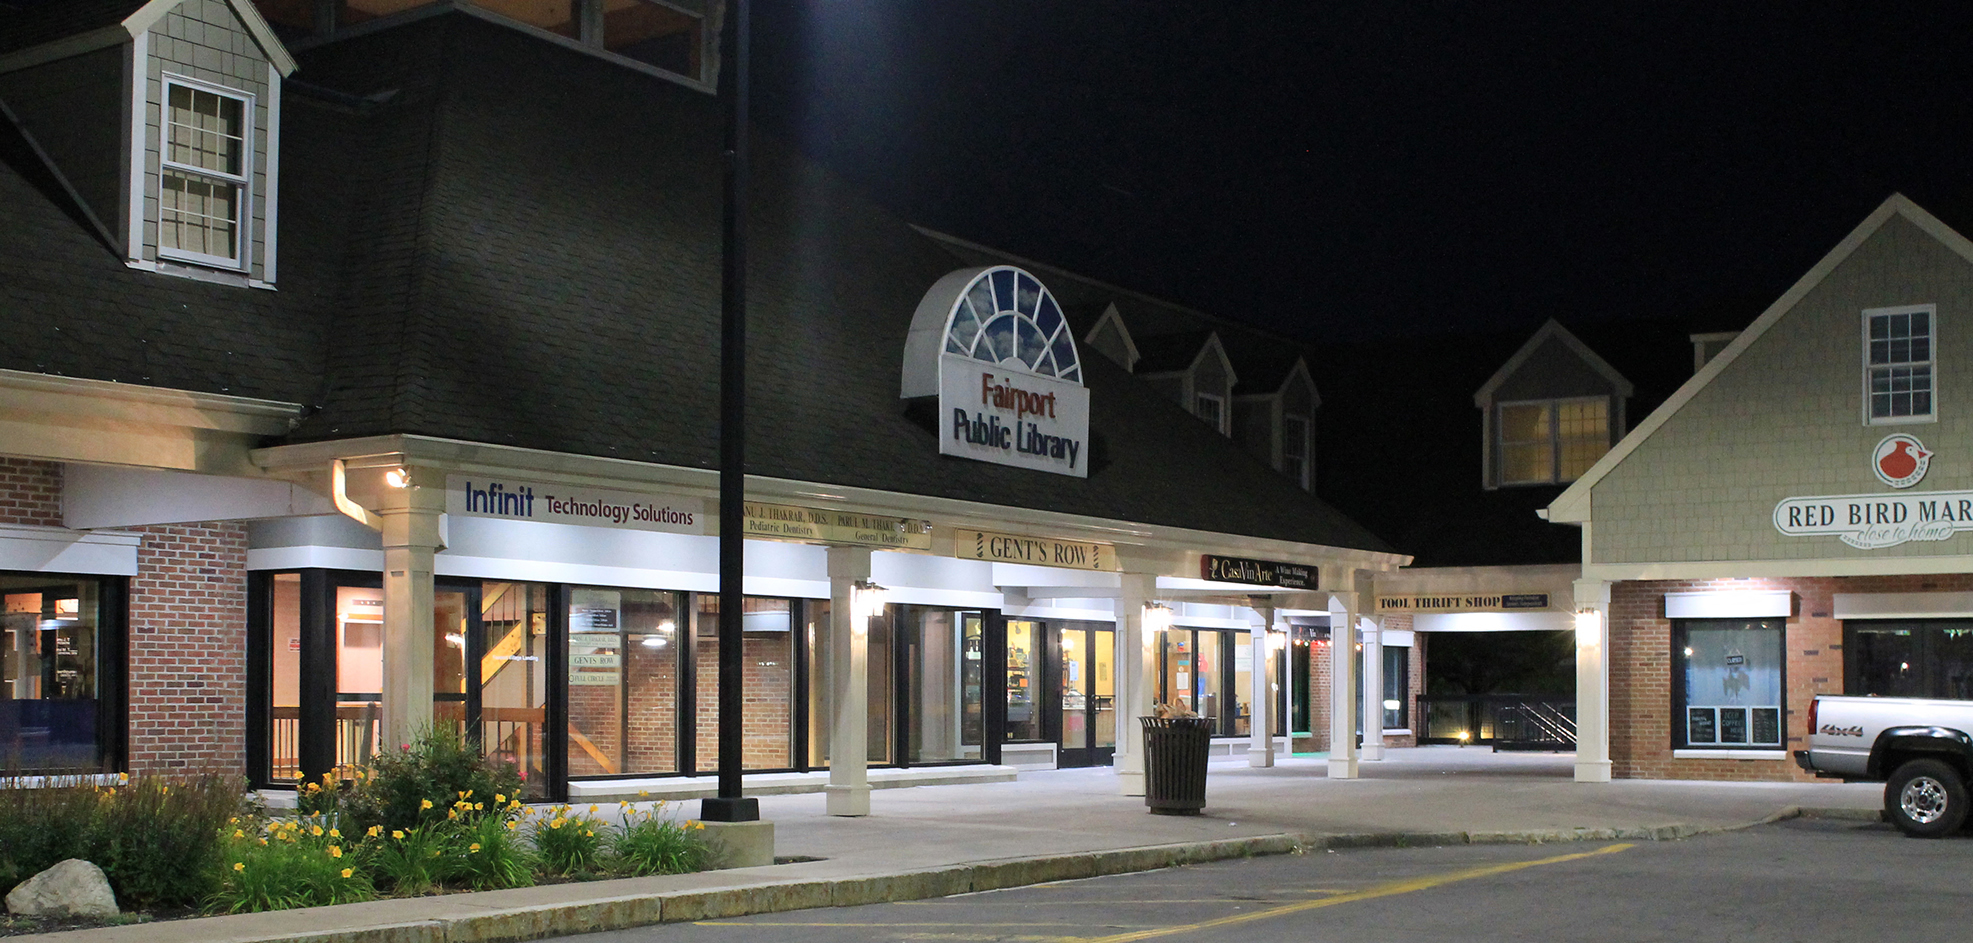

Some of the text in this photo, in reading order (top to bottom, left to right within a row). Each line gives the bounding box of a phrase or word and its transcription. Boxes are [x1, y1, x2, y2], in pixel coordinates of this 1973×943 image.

[982, 373, 1056, 419] Fairport
[954, 407, 1079, 469] Public Library
[466, 481, 693, 525] Infinit Technology Solutions
[1788, 500, 1973, 527] RED BIRD MAR
[750, 521, 813, 537] Pediatric Dentistry
[856, 531, 909, 544] General Dentistry
[1857, 520, 1953, 540] close to home
[990, 537, 1087, 565] GENT'S ROW
[1380, 598, 1410, 608] TOOL
[1414, 597, 1462, 608] THRIFT
[1465, 596, 1500, 608] SHOP
[1820, 724, 1864, 738] 4x4
